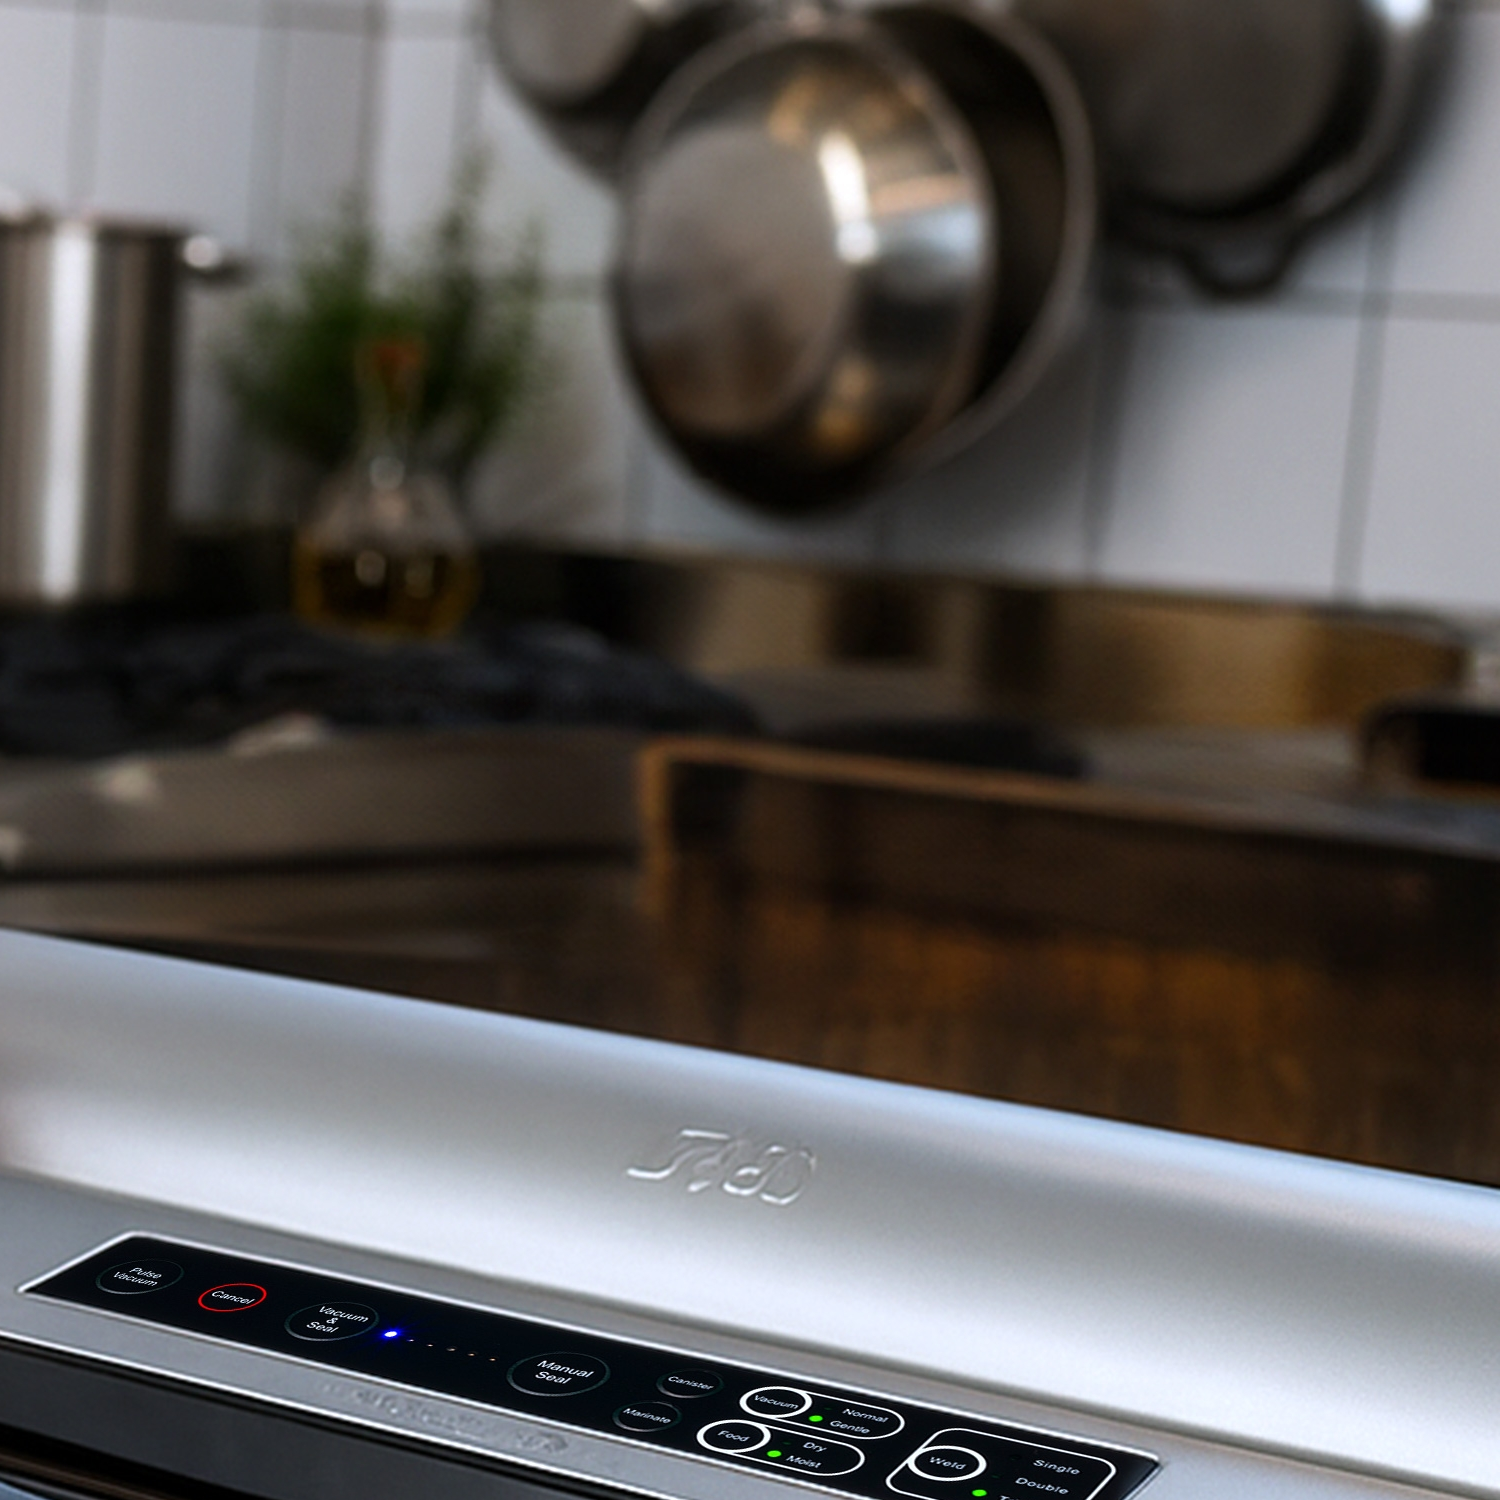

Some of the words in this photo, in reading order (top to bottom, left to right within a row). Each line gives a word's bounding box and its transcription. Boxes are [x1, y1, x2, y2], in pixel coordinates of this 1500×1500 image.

[113, 1271, 158, 1287] Vacuum
[129, 1267, 162, 1280] Pulse
[211, 1290, 255, 1305] Cancel
[318, 1305, 369, 1323] Vacuum
[326, 1317, 339, 1325] &
[306, 1321, 339, 1333] Seal
[536, 1360, 594, 1379] Manual
[534, 1371, 573, 1385] Seal
[667, 1375, 714, 1391] Canister
[753, 1394, 799, 1410] Vacuum
[622, 1407, 672, 1424] Marinate
[842, 1408, 889, 1424] Normal
[829, 1420, 871, 1434] Gentle
[717, 1430, 750, 1443] Food
[802, 1442, 827, 1453] Dry
[785, 1455, 822, 1469] Moist
[928, 1456, 967, 1470] Weld
[1033, 1459, 1081, 1475] Single
[1015, 1477, 1069, 1495] Double
